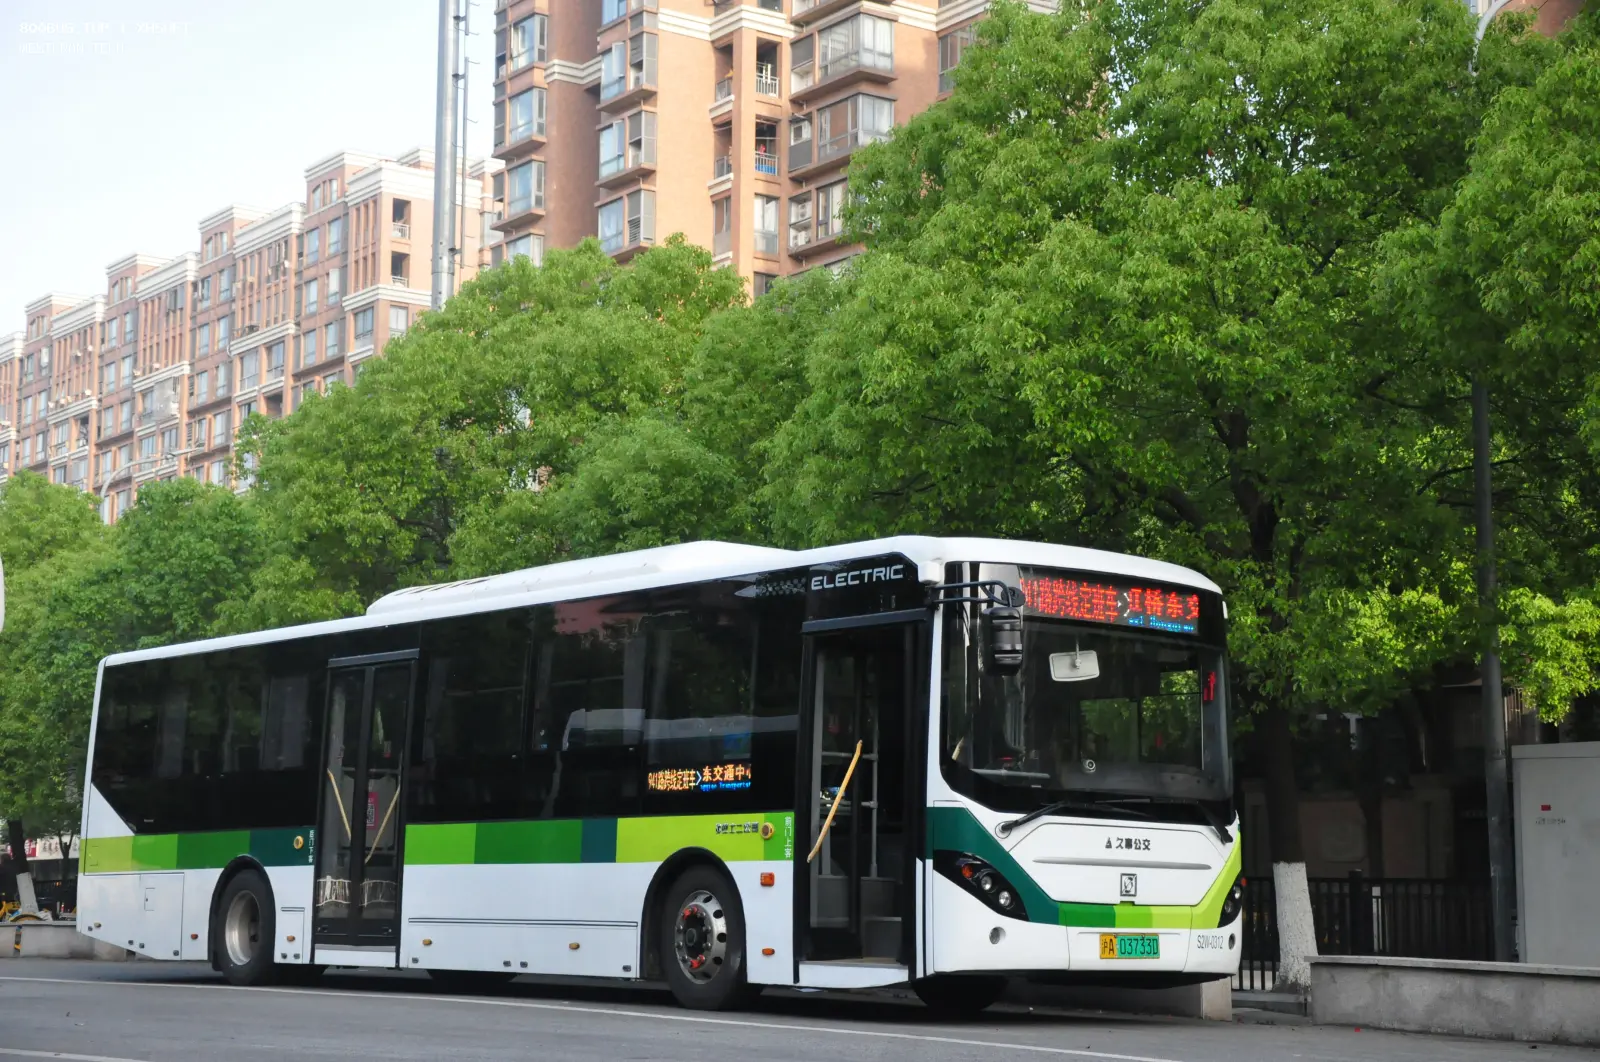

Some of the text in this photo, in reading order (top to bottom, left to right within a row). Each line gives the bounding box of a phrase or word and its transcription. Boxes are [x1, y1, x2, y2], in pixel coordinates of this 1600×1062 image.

[811, 564, 904, 591] ELECTRIC
[1115, 837, 1151, 851] 久事公交
[1120, 938, 1159, 955] 03733D
[1196, 935, 1224, 950] S2W-0312
